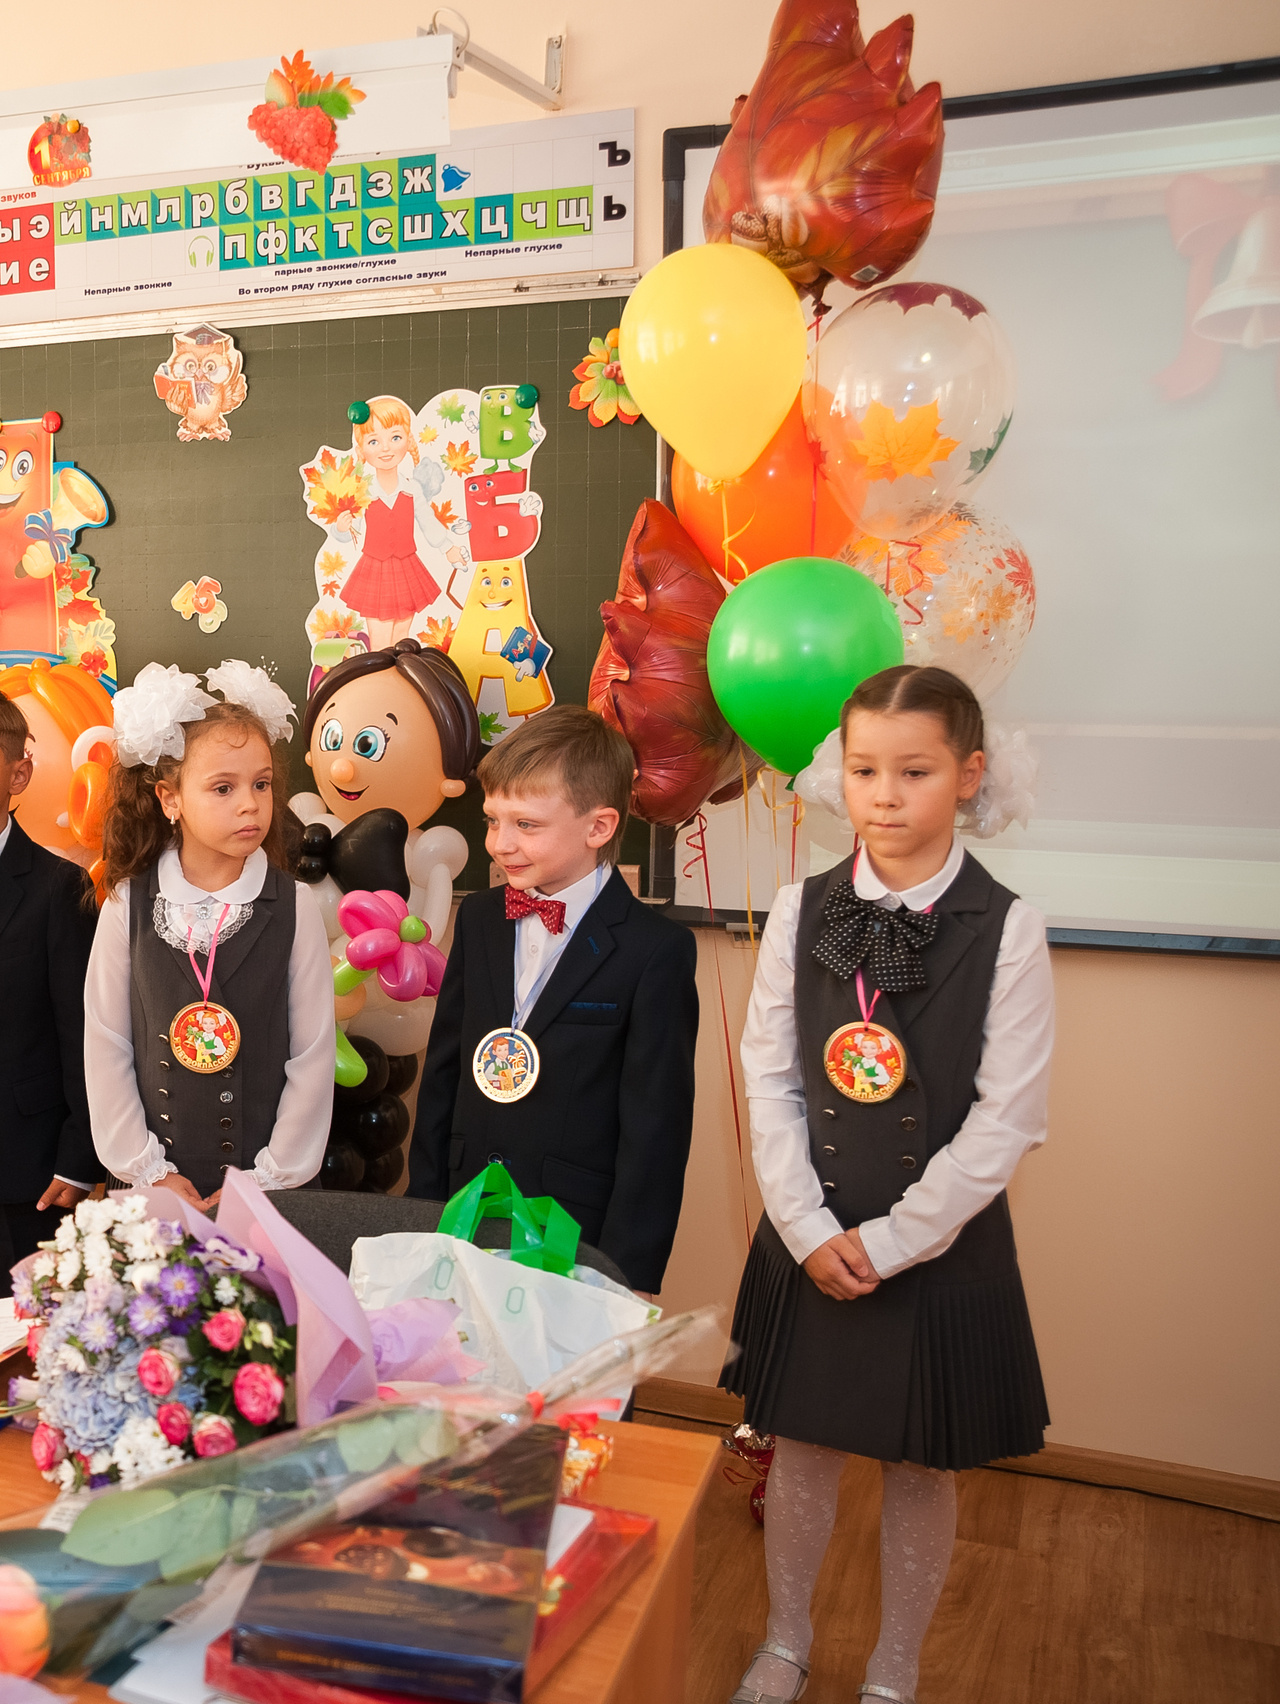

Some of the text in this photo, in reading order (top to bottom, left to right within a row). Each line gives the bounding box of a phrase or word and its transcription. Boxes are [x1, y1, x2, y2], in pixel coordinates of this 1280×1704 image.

[34, 136, 51, 170] 1
[33, 166, 91, 186] СЕНТЯБРЯ
[0, 190, 37, 203] звуков
[464, 242, 563, 258] Непарные глухие
[274, 257, 397, 276] парные звонкие/глухие
[84, 280, 173, 296] Непарные звонкие
[238, 269, 447, 296] Во втором ряду глухие согласные звуки
[175, 1040, 236, 1069] ПЕРВОКЛАССНИЦА
[829, 1067, 901, 1099] ПЕРВОКЛАССНИЦА
